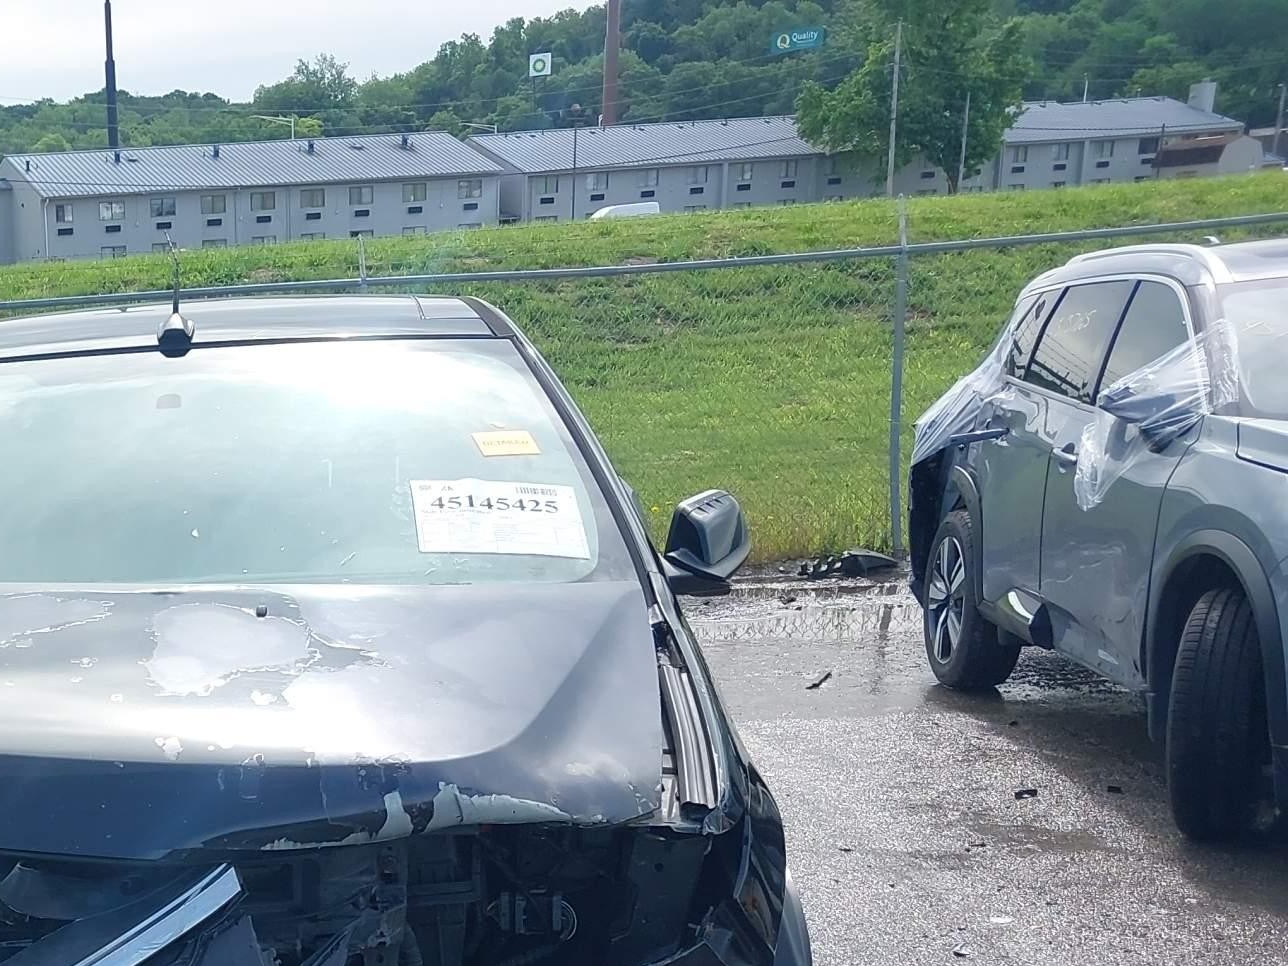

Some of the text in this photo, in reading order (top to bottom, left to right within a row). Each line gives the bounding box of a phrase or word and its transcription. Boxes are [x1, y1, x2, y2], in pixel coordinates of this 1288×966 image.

[776, 31, 818, 49] Q Quality
[430, 494, 559, 514] 45145425
